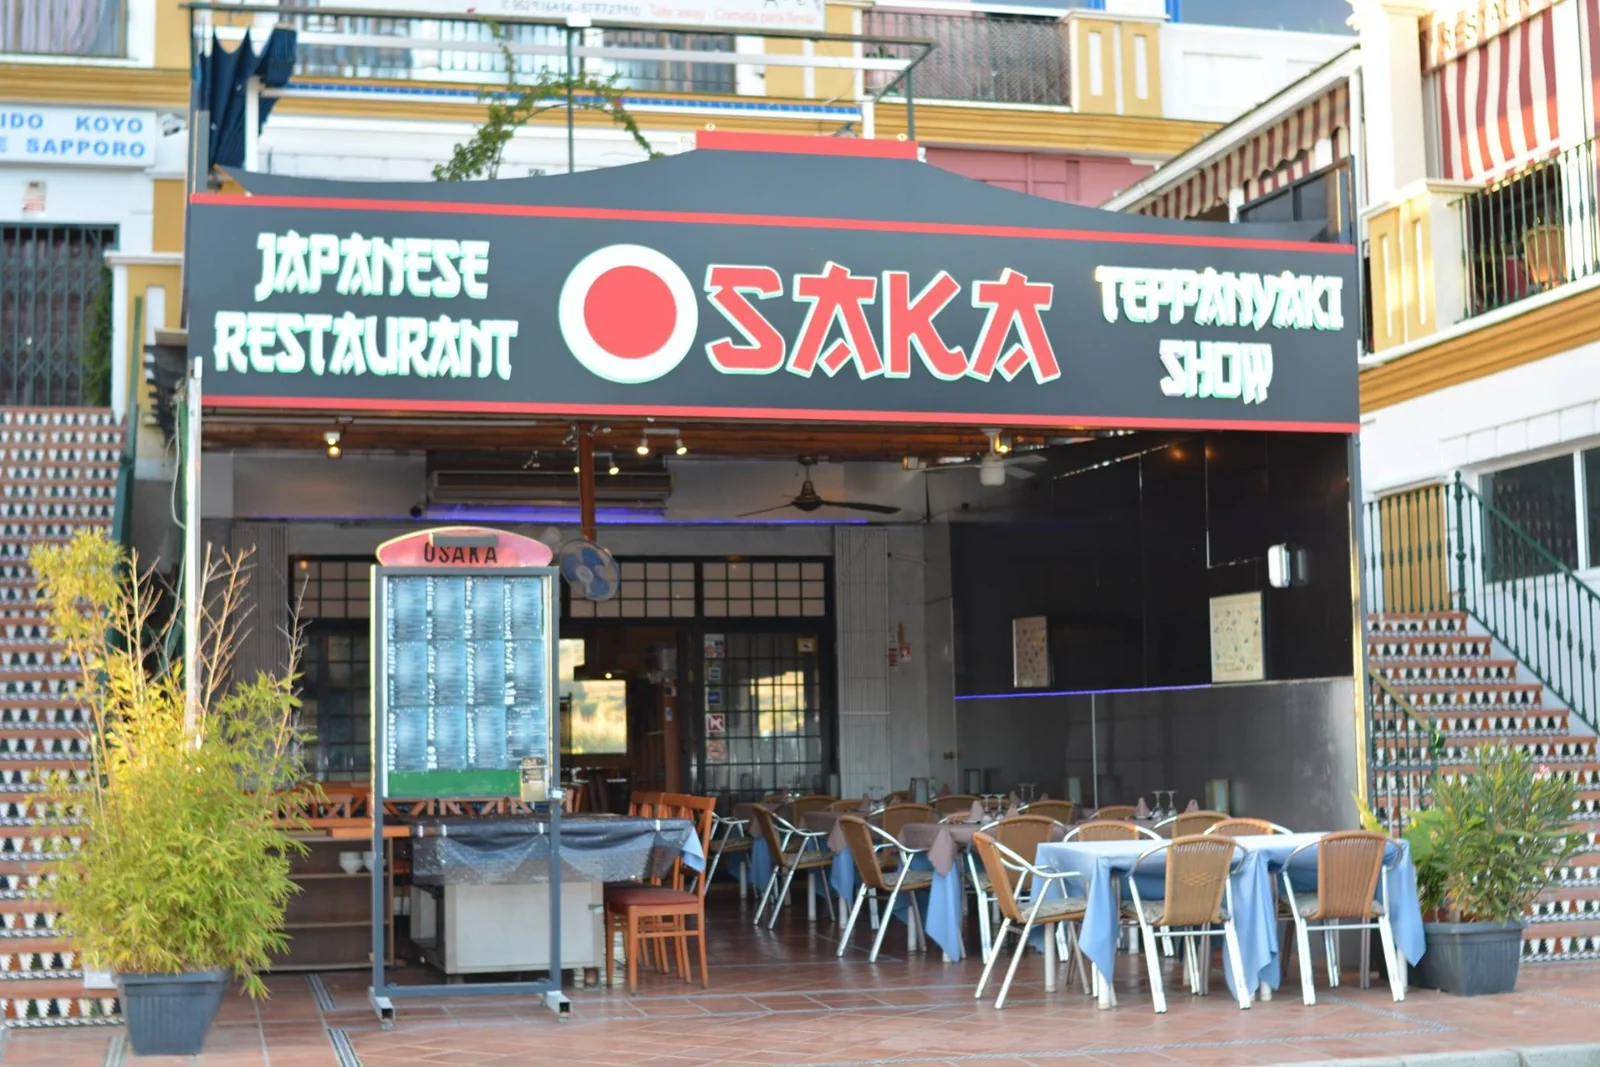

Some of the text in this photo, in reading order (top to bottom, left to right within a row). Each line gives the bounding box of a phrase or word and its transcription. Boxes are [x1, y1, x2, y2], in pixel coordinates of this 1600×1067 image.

[1, 112, 144, 133] IDO KOYO
[26, 137, 147, 158] SAPPORO
[255, 230, 491, 302] JAPANESE
[1095, 264, 1344, 331] TEPPANYAKI
[213, 310, 519, 380] RESTAURANT
[1160, 339, 1274, 405] SHOW
[424, 541, 498, 564] OSAKA
